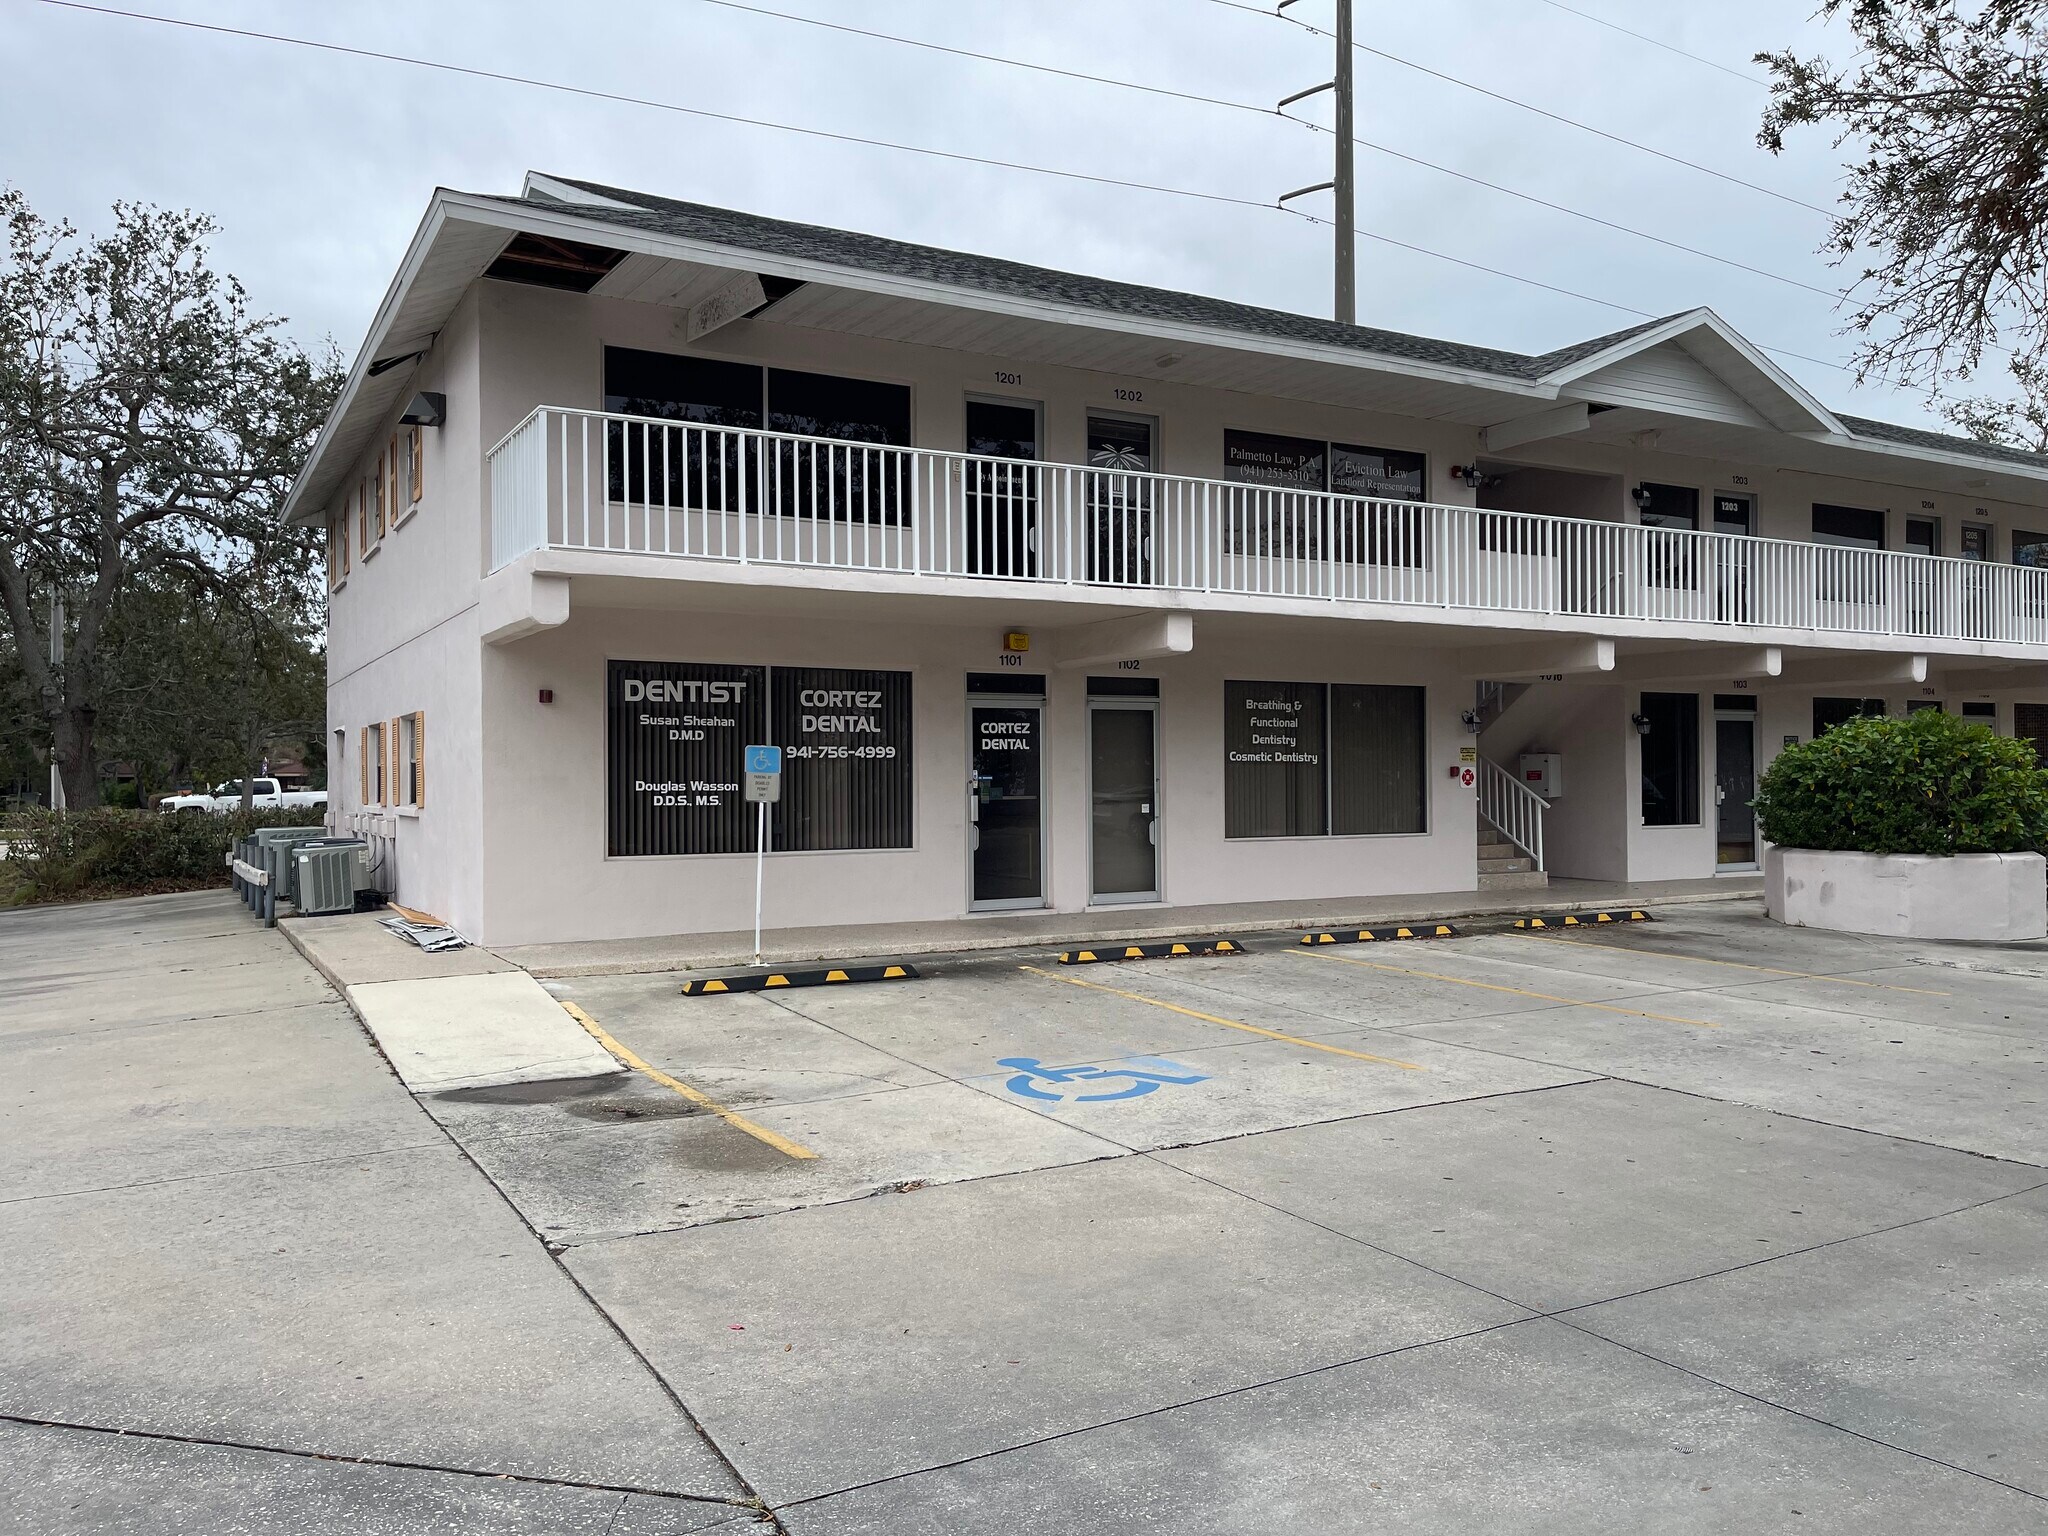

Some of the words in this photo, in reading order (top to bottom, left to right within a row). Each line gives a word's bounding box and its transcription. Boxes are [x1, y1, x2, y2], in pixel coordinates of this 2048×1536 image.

[994, 371, 1022, 385] 1201
[1114, 389, 1143, 402] 1202
[1230, 447, 1272, 462] Palmetto
[1275, 453, 1296, 467] Law,
[1300, 455, 1318, 468] P.A.
[1240, 464, 1265, 479] (941)
[1267, 467, 1309, 481] 253-5310
[1345, 461, 1385, 477] Eviction
[1388, 466, 1409, 479] Law
[1331, 475, 1365, 488] Landlord
[1367, 479, 1421, 494] Representation
[1732, 476, 1748, 485] 1203
[1722, 502, 1738, 512] 1203
[1976, 508, 1988, 516] 1205
[999, 655, 1022, 666] 1101
[624, 680, 747, 703] DENTIST
[1733, 681, 1748, 689] 1103
[800, 690, 881, 708] CORTEZ
[1246, 700, 1292, 713] Breathing
[1294, 701, 1302, 711] &
[640, 715, 680, 726] Susan
[684, 716, 735, 727] Sheahan
[802, 715, 881, 732] DENTAL
[1250, 717, 1298, 728] Functional
[981, 722, 1030, 734] CORTEZ
[670, 730, 705, 741] D.M.D
[1252, 734, 1296, 747] Dentistry
[982, 738, 1030, 750] DENTAL
[786, 746, 896, 758] 941-756-4999
[1229, 751, 1272, 761] Cosmetic
[1274, 752, 1318, 764] Dentistry
[636, 781, 686, 794] Douglas
[690, 782, 739, 791] Wasson
[654, 796, 692, 806] D.D.S.,
[696, 796, 722, 806] M.S.
